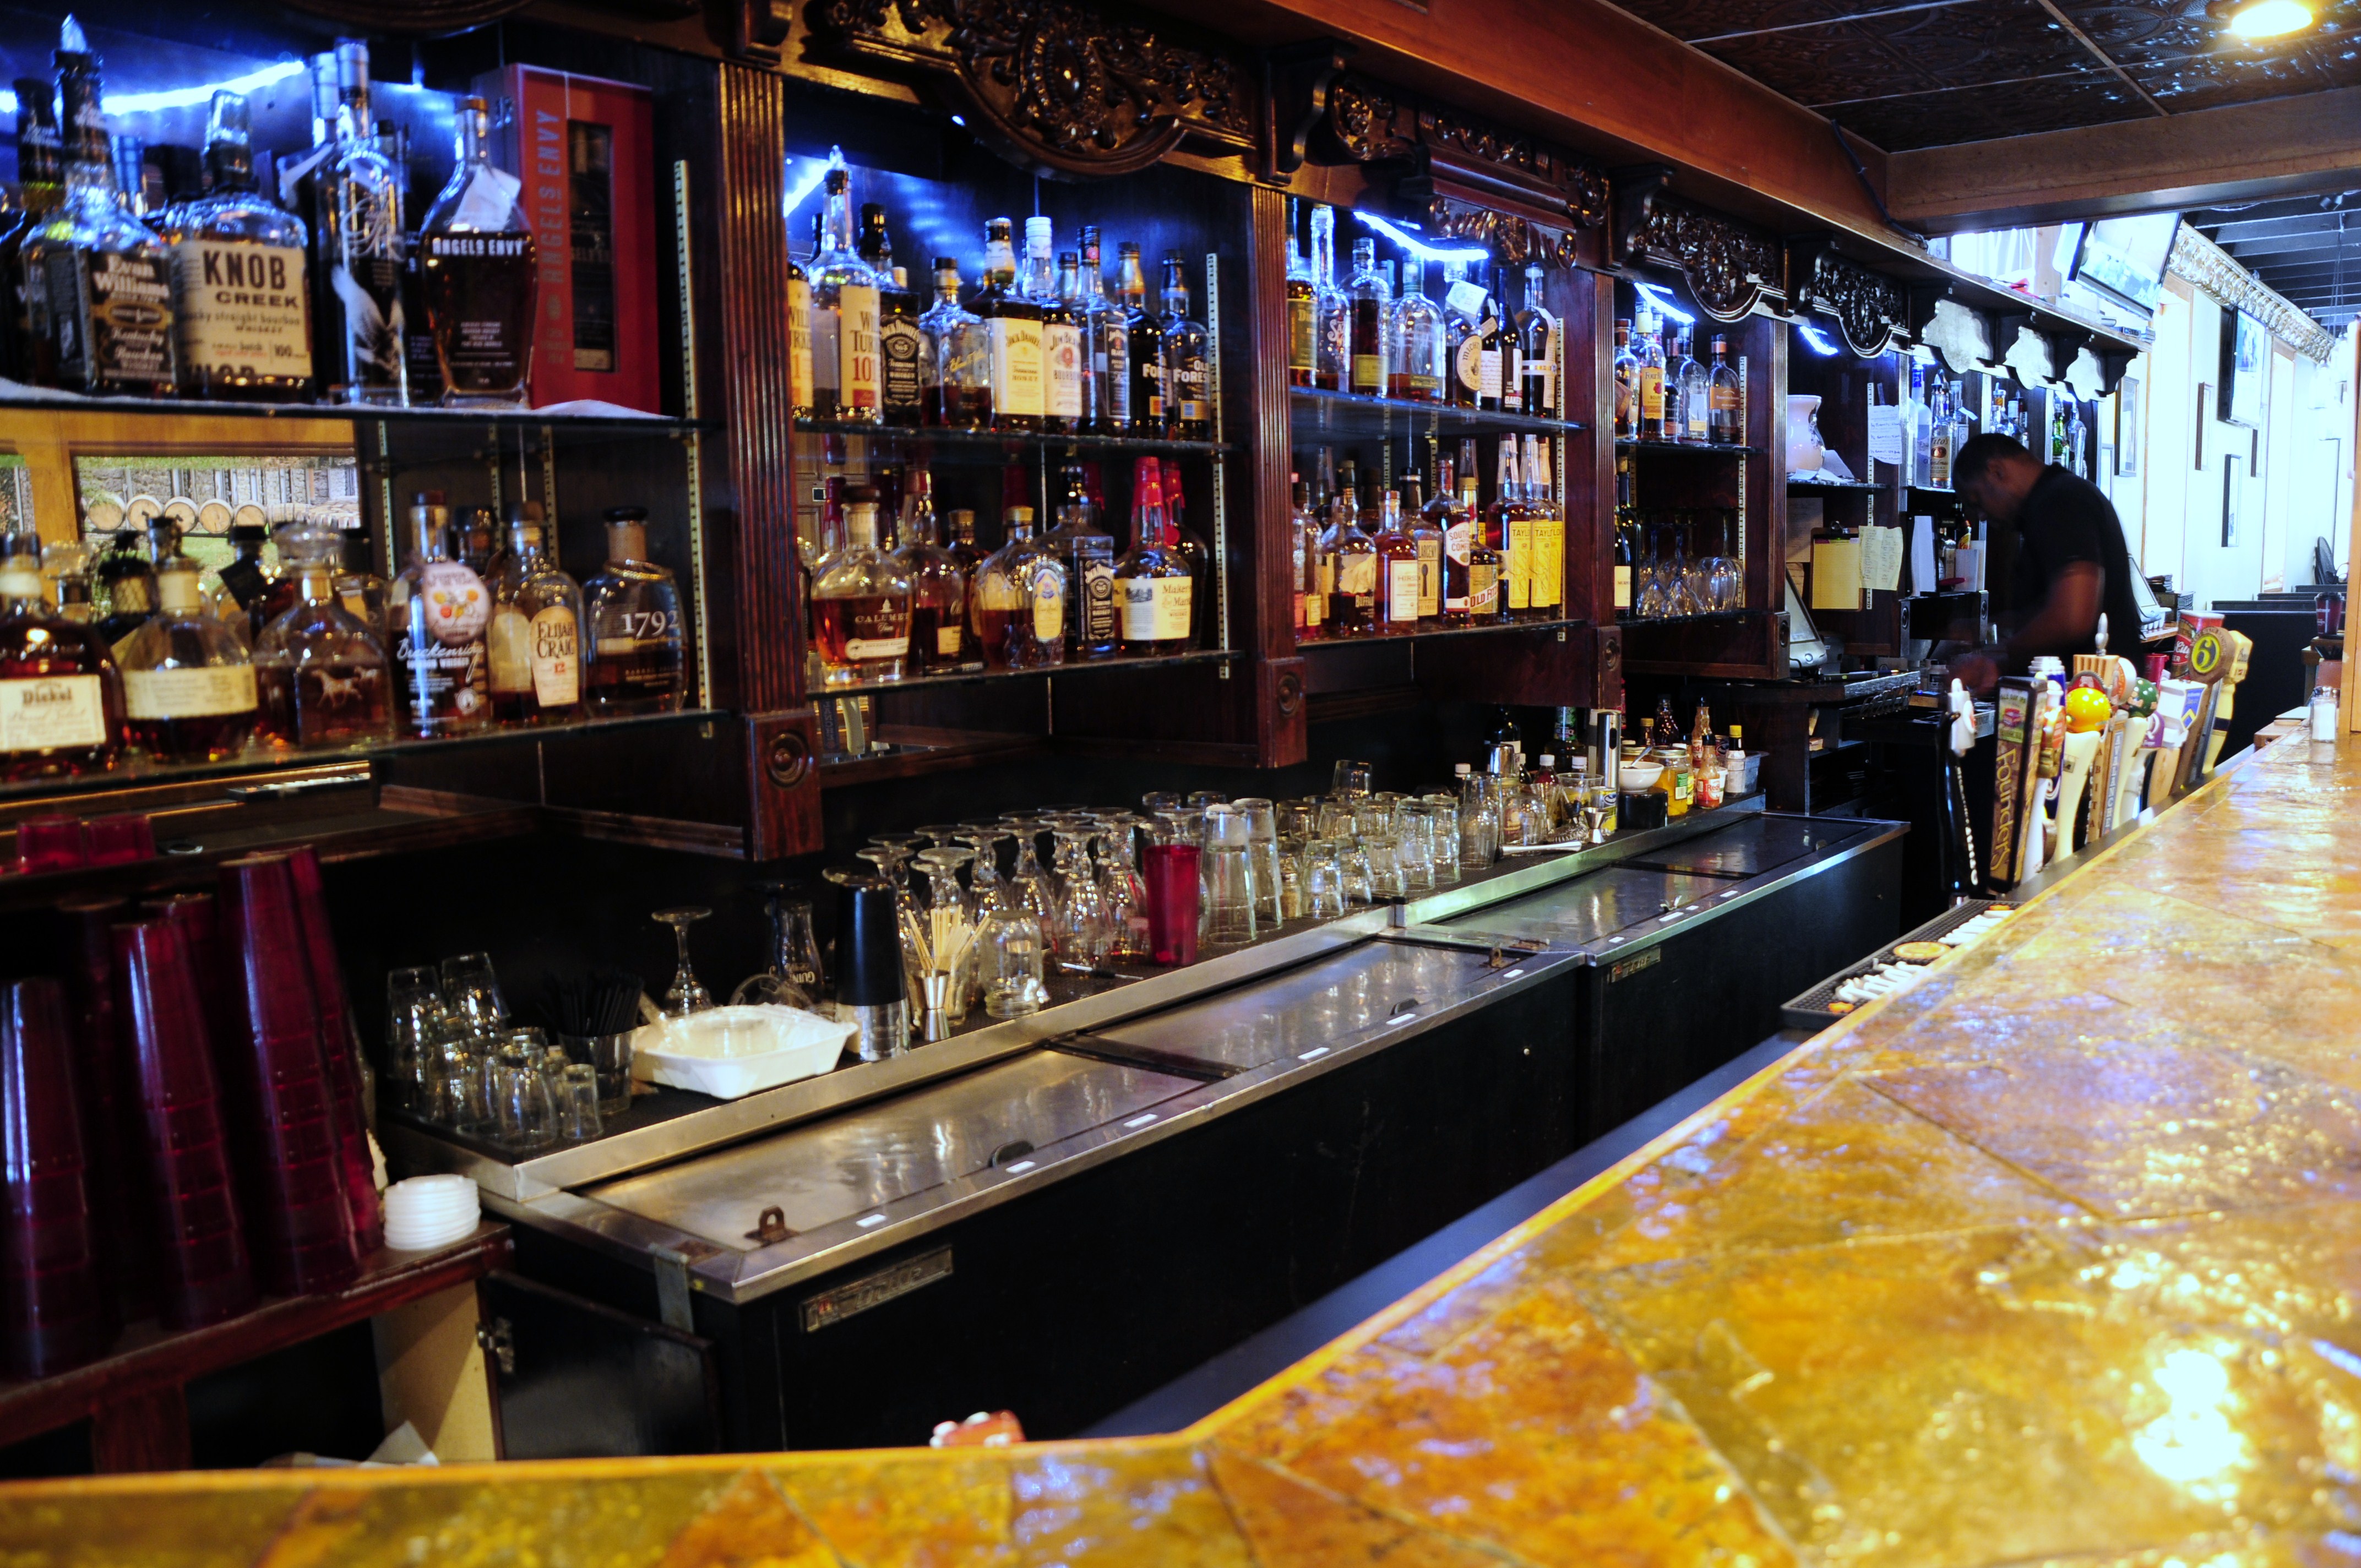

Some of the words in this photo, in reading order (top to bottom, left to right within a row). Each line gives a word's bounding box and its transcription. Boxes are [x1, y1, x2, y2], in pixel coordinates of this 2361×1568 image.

[536, 109, 561, 176] ENVY
[488, 238, 523, 256] ENVY
[108, 254, 156, 278] Evan
[203, 249, 286, 290] KNOB
[93, 271, 170, 300] Williams
[215, 290, 300, 311] CREEK
[1053, 369, 1081, 381] BOURBO
[1470, 592, 1486, 608] OLD
[536, 619, 574, 639] ELIJAH
[621, 609, 681, 640] 1792
[536, 638, 575, 659] CRAIG
[2191, 634, 2221, 673] 6
[21, 688, 73, 706] Dickel
[2090, 748, 2103, 828] ABITA
[1990, 748, 2017, 871] Founders
